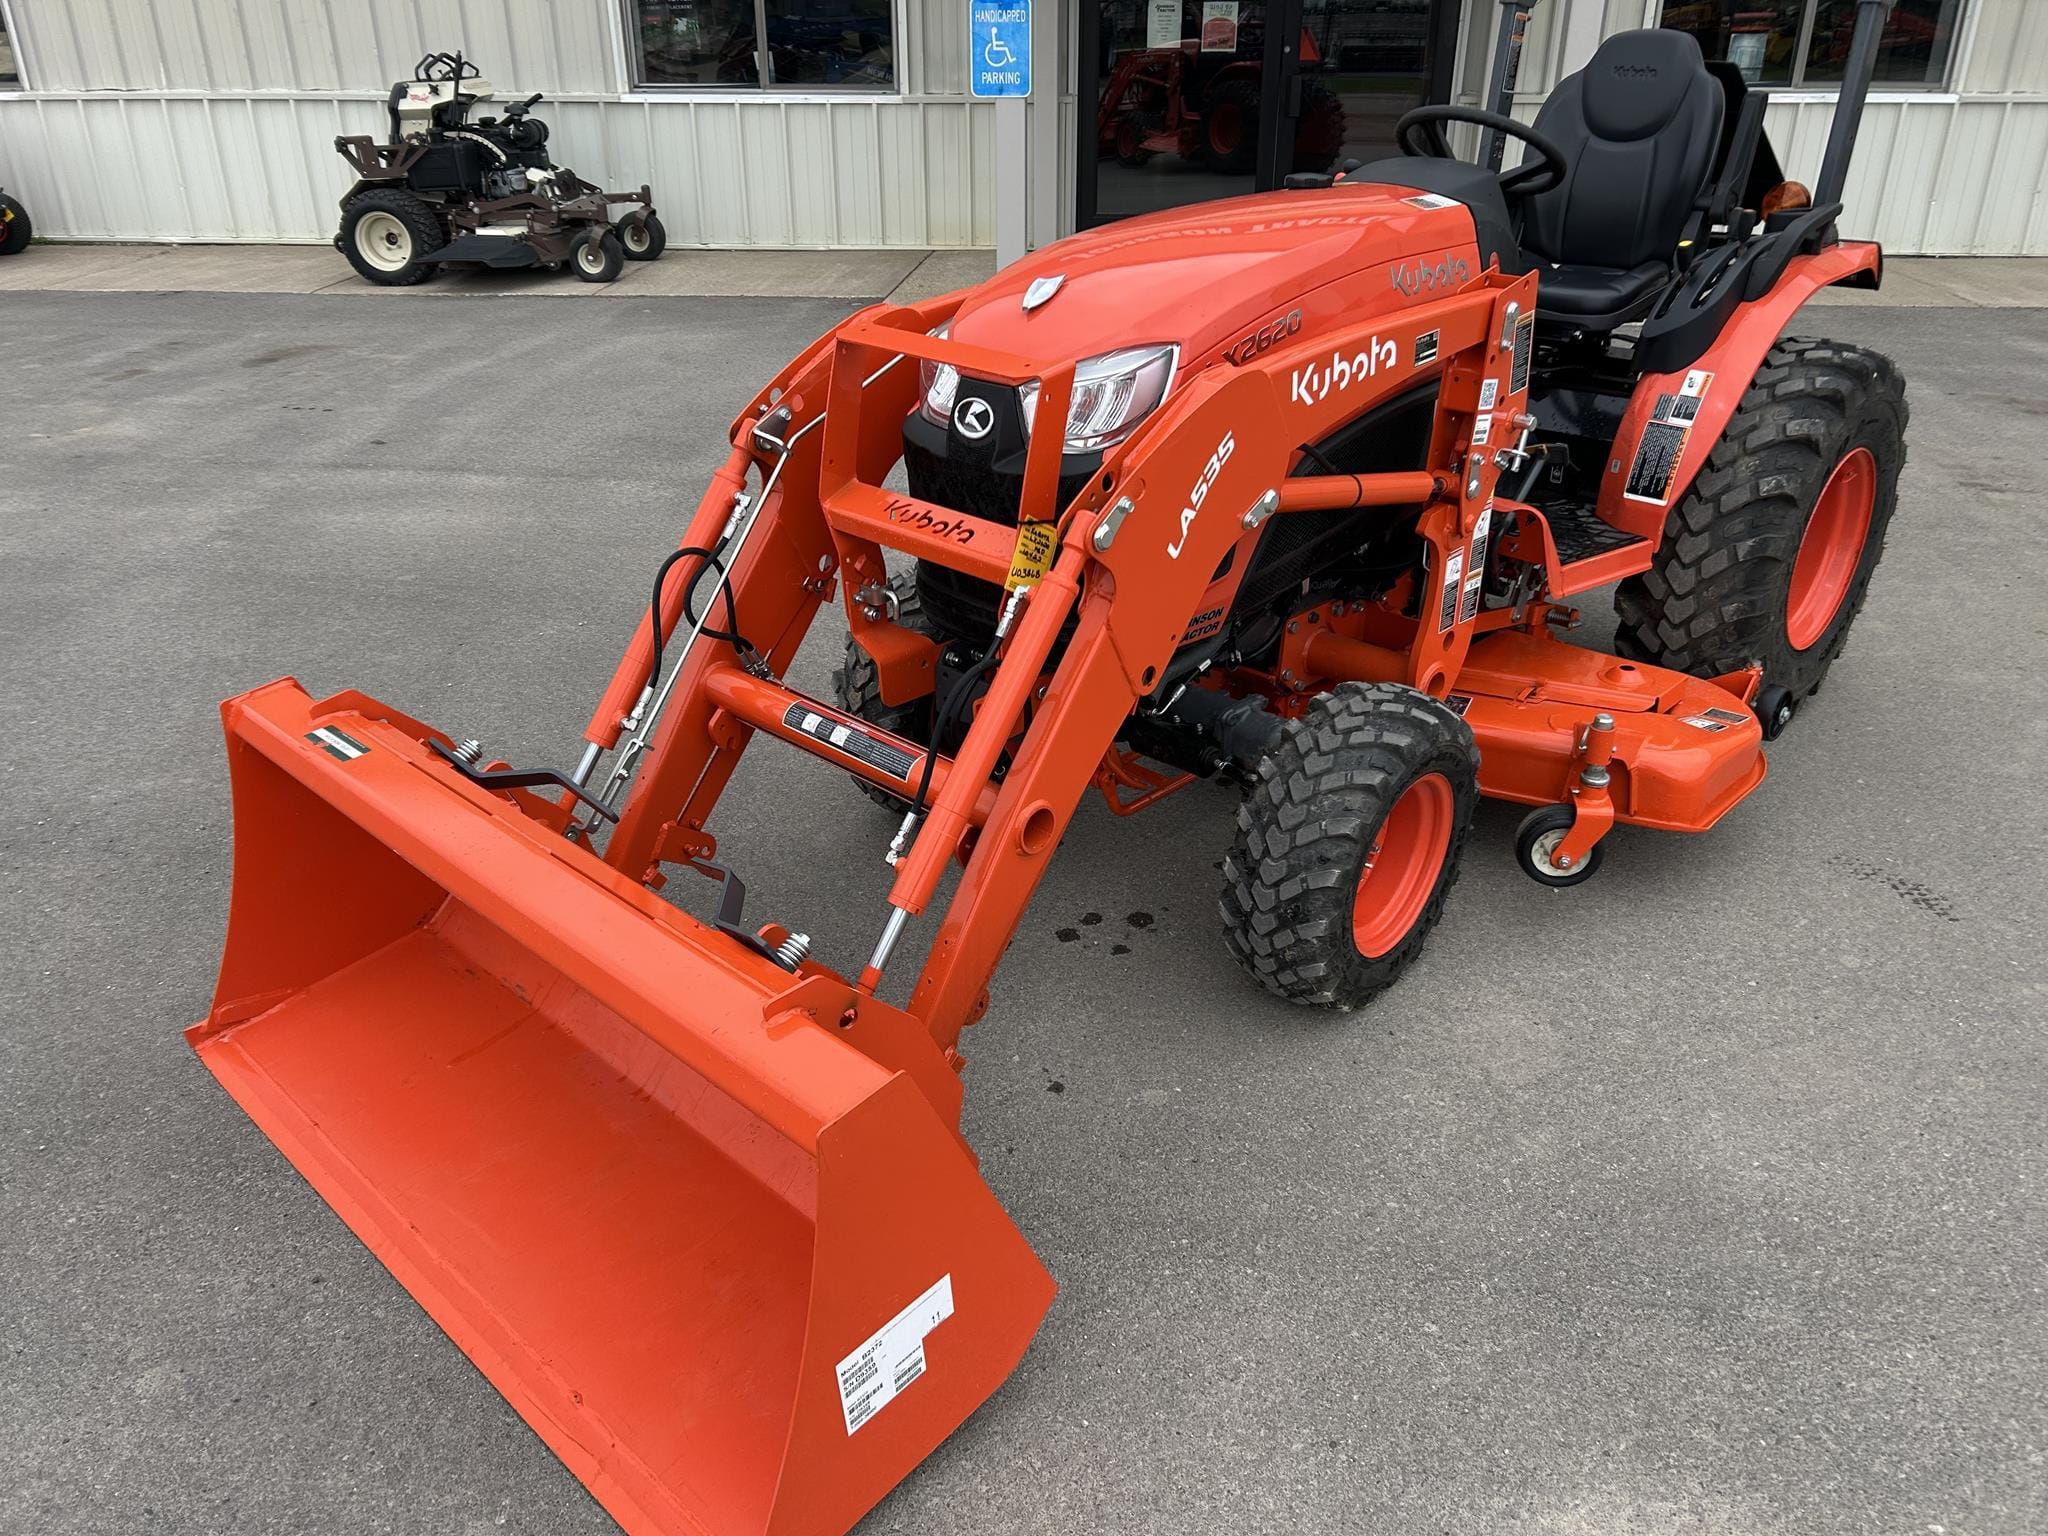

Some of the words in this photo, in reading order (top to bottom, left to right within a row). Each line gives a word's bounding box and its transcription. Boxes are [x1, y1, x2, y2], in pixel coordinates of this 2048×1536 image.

[975, 9, 1026, 22] HANDICAPPED
[981, 71, 1021, 85] PARKING
[1391, 252, 1470, 296] Kubota
[1219, 308, 1304, 368] X2620
[1291, 335, 1397, 406] Kubota
[1167, 429, 1235, 560] LA535
[884, 499, 976, 545] Kubota
[1180, 621, 1220, 642] ACTOR
[1188, 606, 1225, 627] NSON
